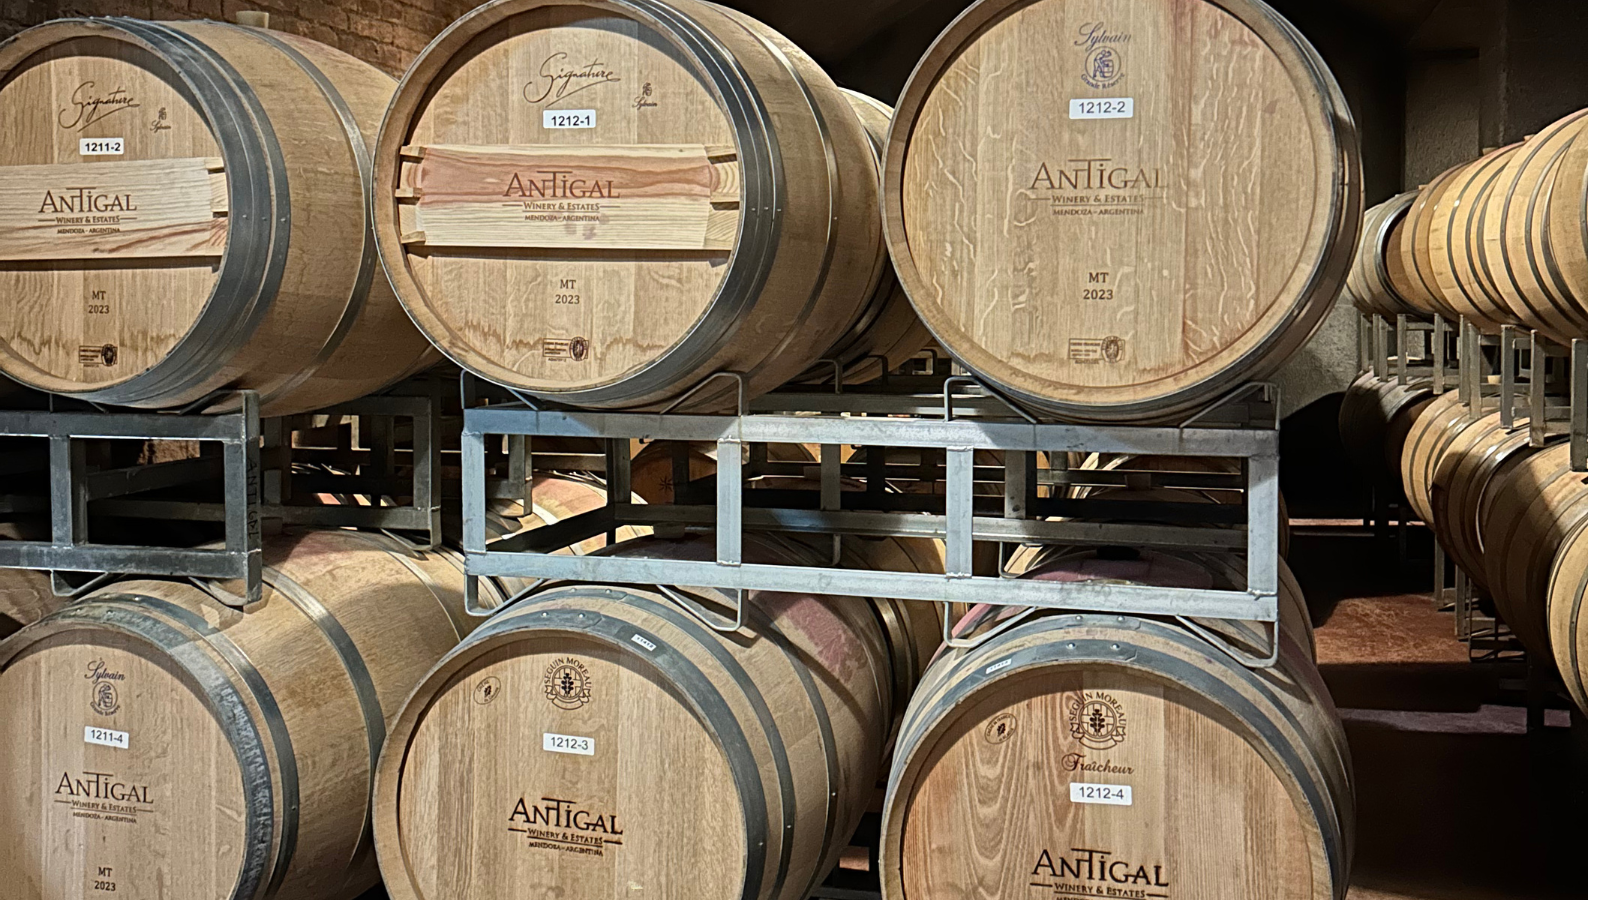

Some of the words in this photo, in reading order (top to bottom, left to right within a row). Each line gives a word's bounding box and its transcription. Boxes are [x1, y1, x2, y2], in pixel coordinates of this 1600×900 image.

[1074, 22, 1132, 52] Sylvain
[523, 52, 621, 108] Signature
[58, 81, 140, 132] Signature
[1079, 101, 1126, 114] 1212-2
[551, 115, 590, 127] 1212-1
[85, 142, 121, 152] 1211-2
[1052, 194, 1091, 203] WINERY
[1093, 195, 1101, 203] &
[1104, 194, 1144, 203] ESTATES
[523, 202, 557, 210] WINERY
[558, 202, 565, 210] &
[567, 202, 600, 211] ESTATES
[1053, 208, 1092, 216] MENDOZA
[1099, 208, 1144, 216] ARGENTINA
[1089, 272, 1109, 283] MT
[560, 279, 577, 290] MT
[92, 290, 107, 301] MT
[555, 294, 580, 305] 2023
[1083, 289, 1114, 300] 2023
[88, 304, 110, 314] 2023
[84, 660, 125, 684] Sylvain
[544, 657, 565, 684] SEGUIN
[566, 657, 592, 689] MOREAU
[1069, 691, 1093, 721] SEGUIN
[1096, 691, 1127, 726] MOREAU
[91, 729, 123, 743] 1211-4
[551, 736, 588, 750] 1212-3
[1061, 752, 1134, 775] Fraîcheur
[1079, 786, 1124, 799] 1212-4
[71, 800, 99, 810] WINERY
[109, 803, 137, 813] ESTATES
[527, 828, 560, 839] WINERY
[562, 832, 568, 840] &
[571, 833, 603, 845] ESTATES
[98, 866, 113, 877] MT
[94, 880, 116, 892] 2023
[1054, 882, 1093, 893] WINERY
[1096, 885, 1103, 894] &
[1106, 887, 1146, 898] ESTATES
